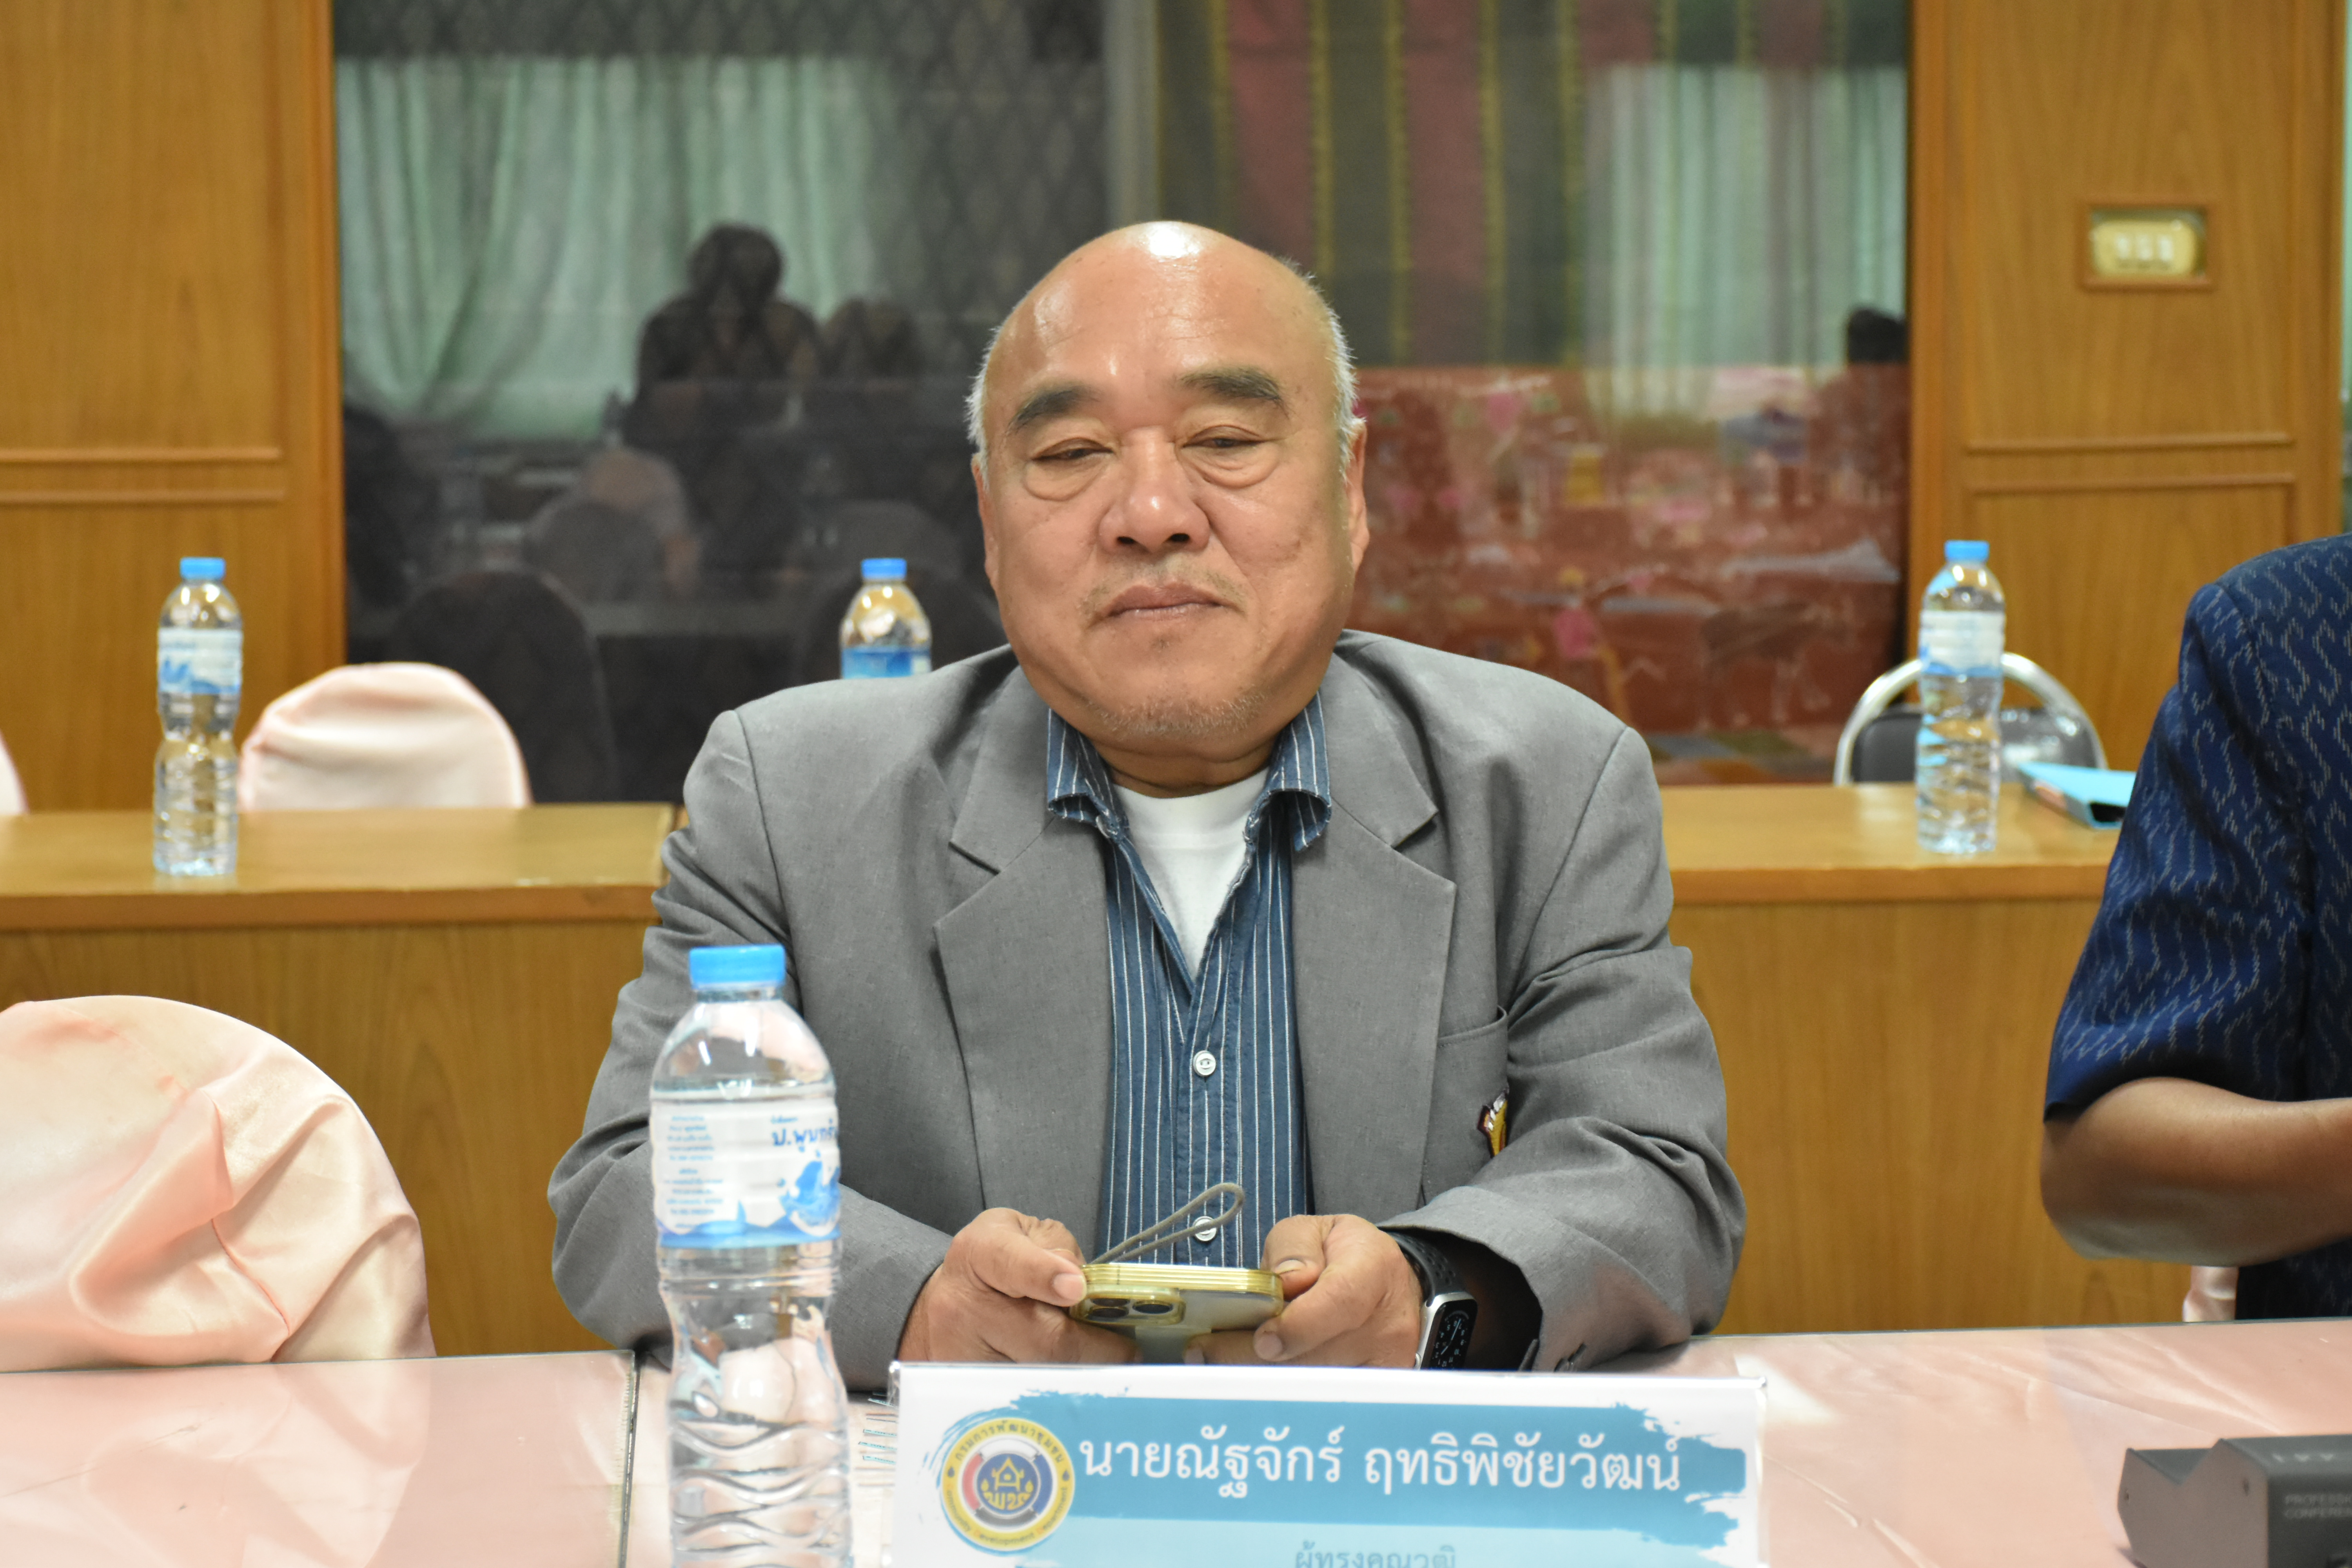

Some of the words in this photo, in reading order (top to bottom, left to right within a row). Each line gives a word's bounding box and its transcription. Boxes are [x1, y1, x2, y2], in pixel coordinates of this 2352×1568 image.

[1079, 1425, 1345, 1498] นายณัฐจักร์
[1365, 1431, 1681, 1495] ฤทธิพิชัยวัฒน์
